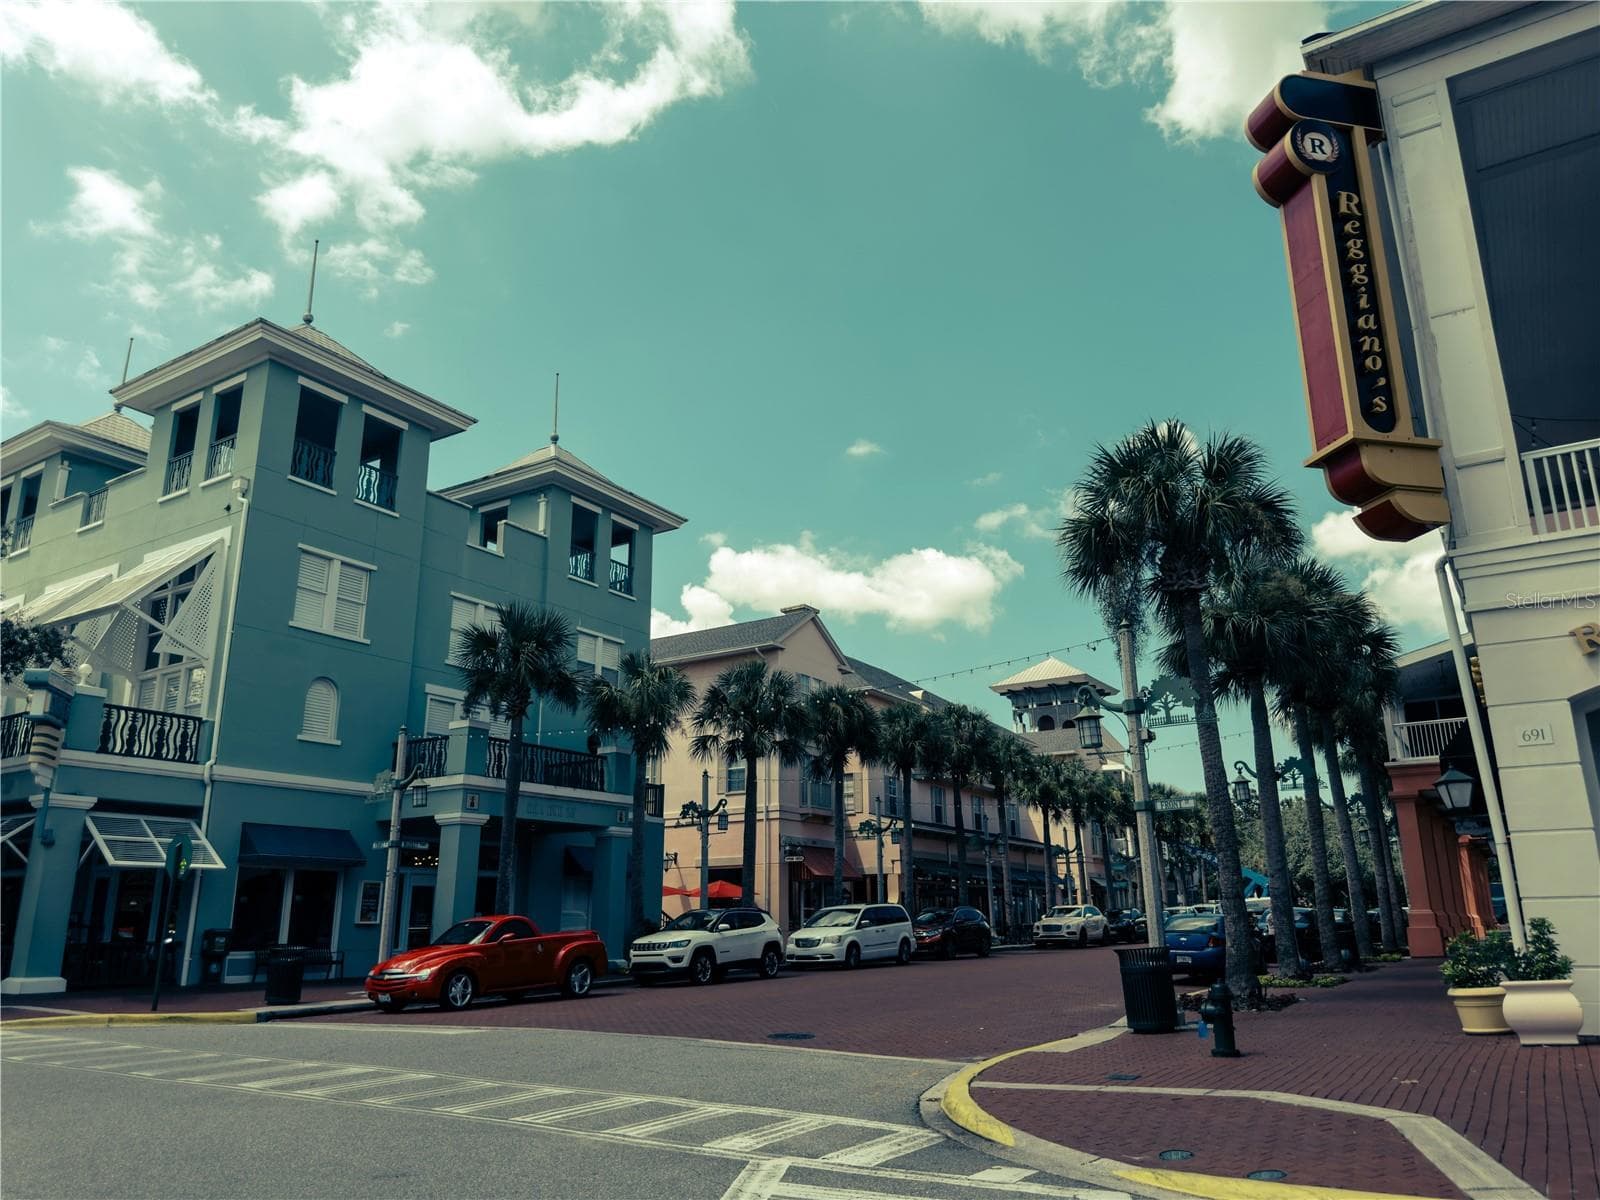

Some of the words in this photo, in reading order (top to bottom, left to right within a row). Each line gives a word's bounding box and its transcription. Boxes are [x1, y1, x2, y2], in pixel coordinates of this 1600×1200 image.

[1308, 137, 1328, 155] R
[1336, 191, 1388, 413] Reggiano's
[1521, 728, 1547, 743] 691
[1160, 799, 1184, 811] FRONT
